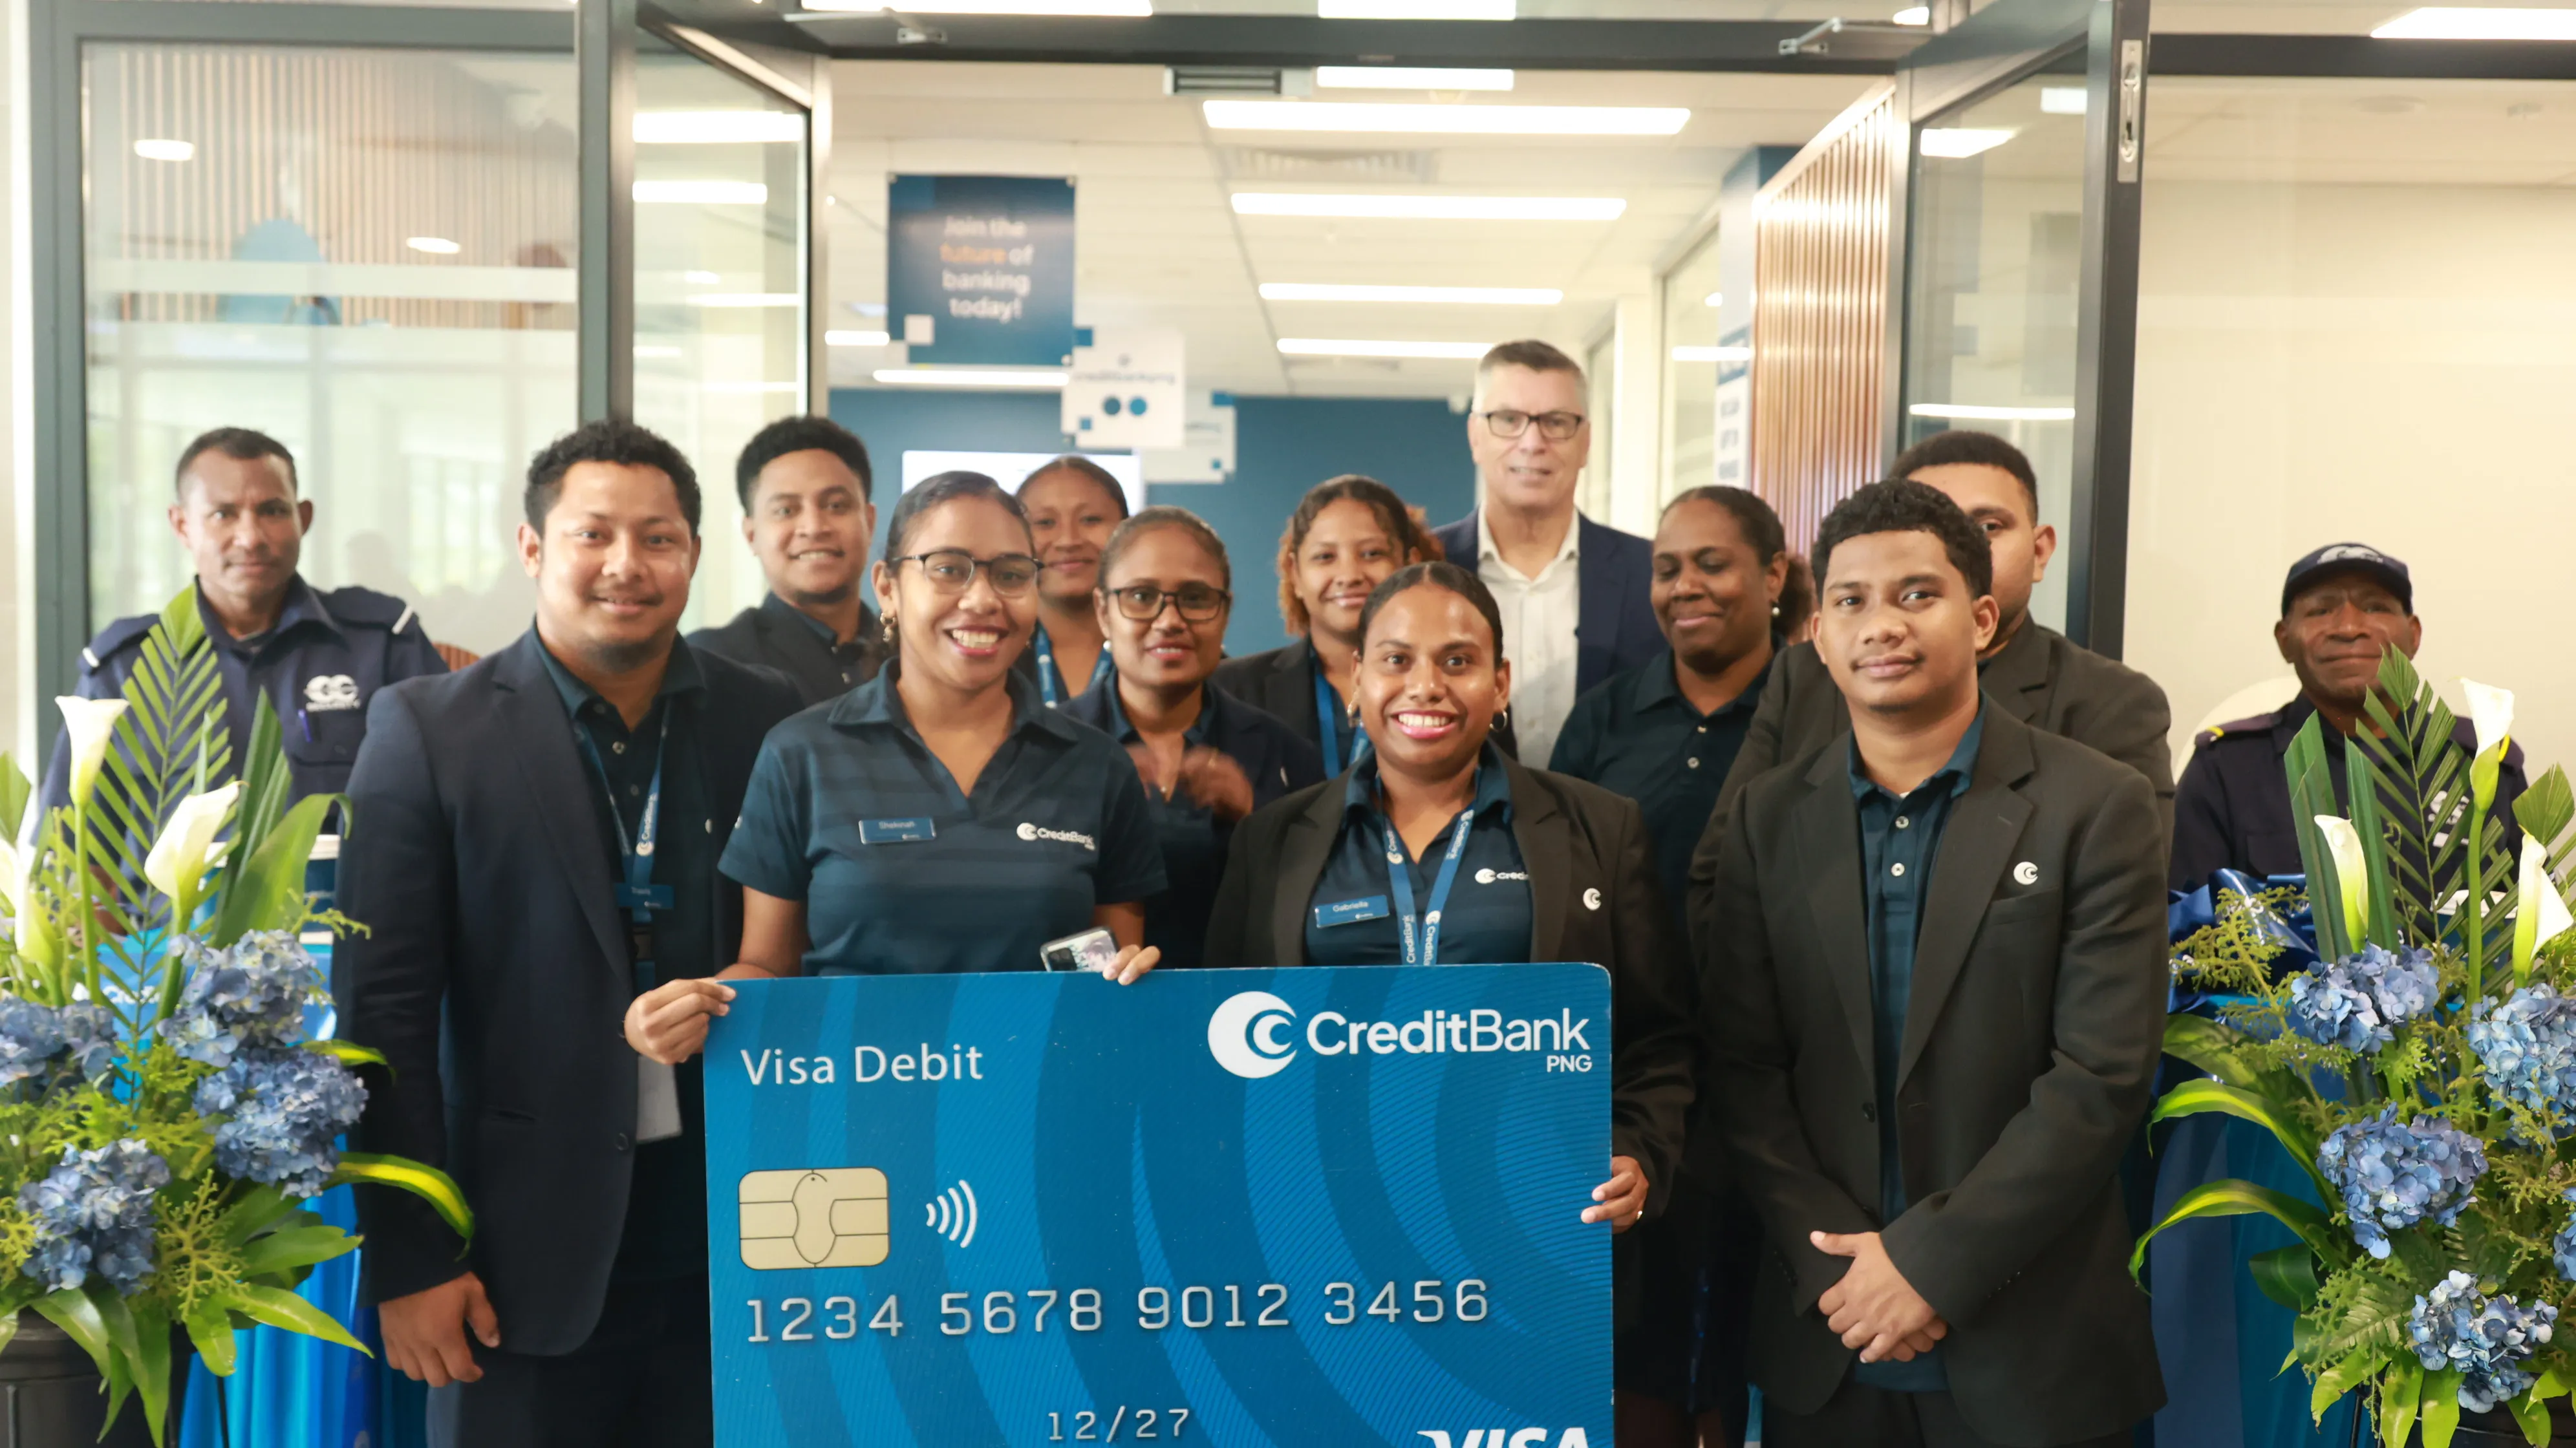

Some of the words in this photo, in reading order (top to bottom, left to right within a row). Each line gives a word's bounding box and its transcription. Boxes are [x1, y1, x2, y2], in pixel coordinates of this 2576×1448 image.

[944, 216, 986, 237] Join
[989, 217, 1027, 238] the
[1008, 244, 1033, 266] of
[941, 269, 1031, 297] banking
[949, 296, 1022, 323] today!
[1306, 1007, 1591, 1056] CreditBank
[741, 1049, 835, 1085] Visa
[855, 1042, 983, 1083] Debit
[1546, 1054, 1593, 1073] PNG
[746, 1294, 903, 1343] 1234
[939, 1288, 1102, 1336] 5678
[1137, 1283, 1289, 1330] 9012
[1324, 1279, 1487, 1325] 3456
[1048, 1405, 1189, 1443] 12/27
